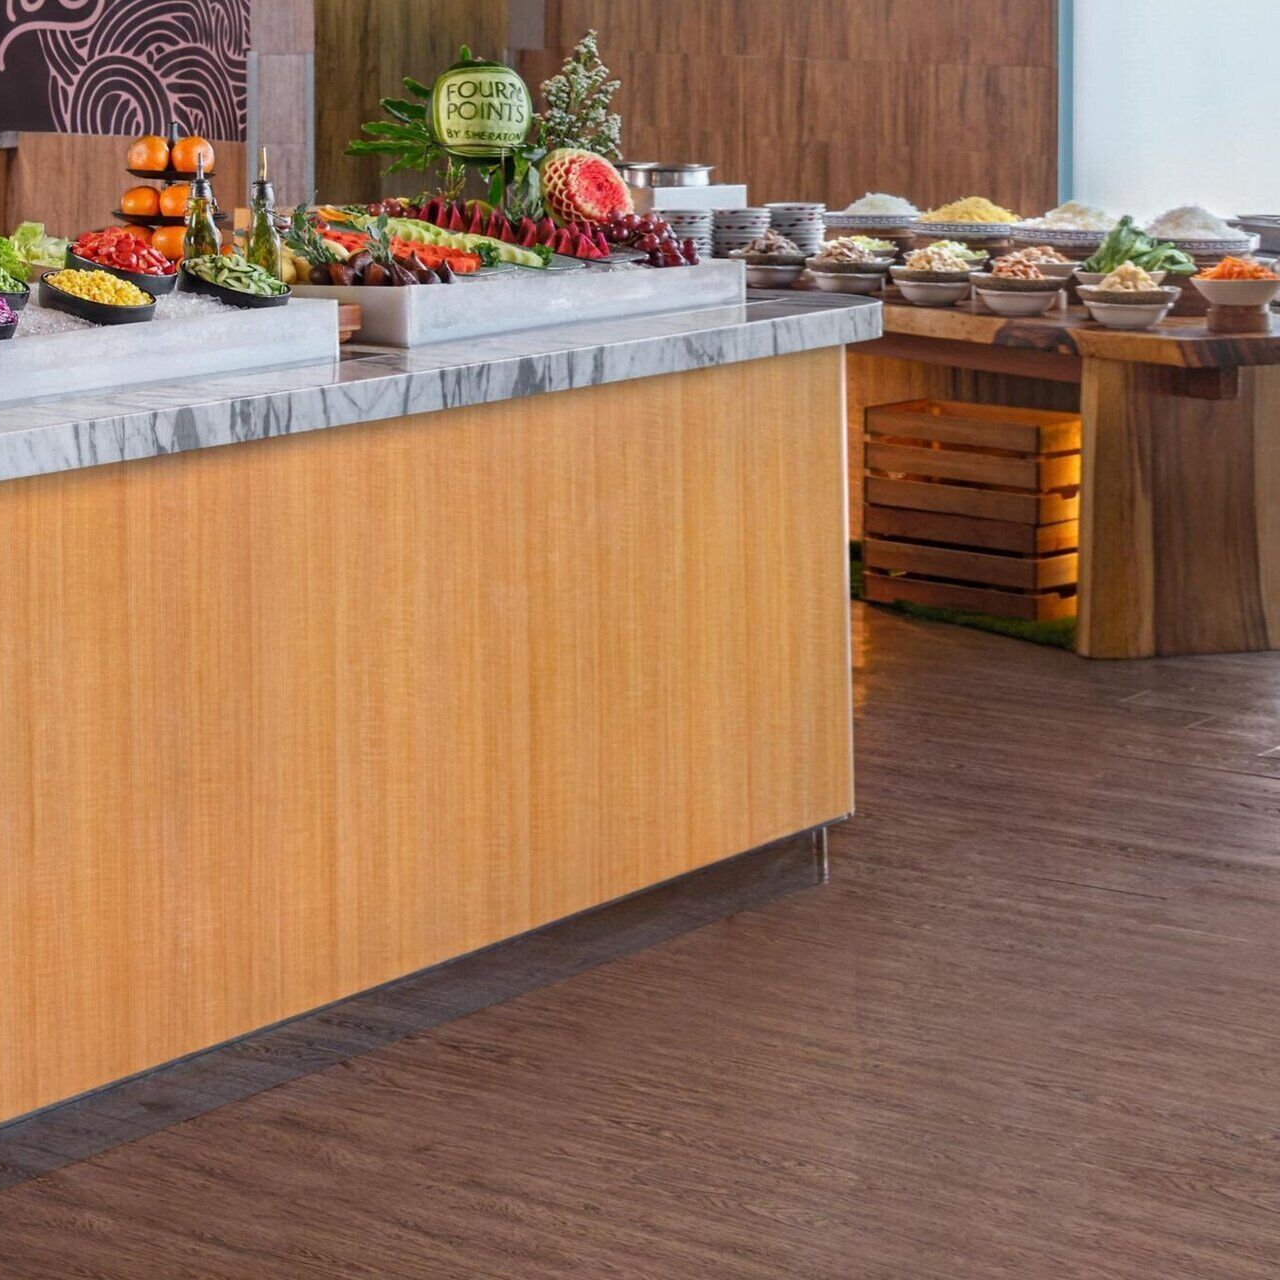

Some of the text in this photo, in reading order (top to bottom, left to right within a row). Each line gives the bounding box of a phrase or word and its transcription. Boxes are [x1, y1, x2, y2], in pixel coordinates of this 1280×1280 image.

[446, 80, 509, 102] FOUR
[447, 101, 525, 124] POINTS
[446, 128, 523, 141] BY SHERATON
